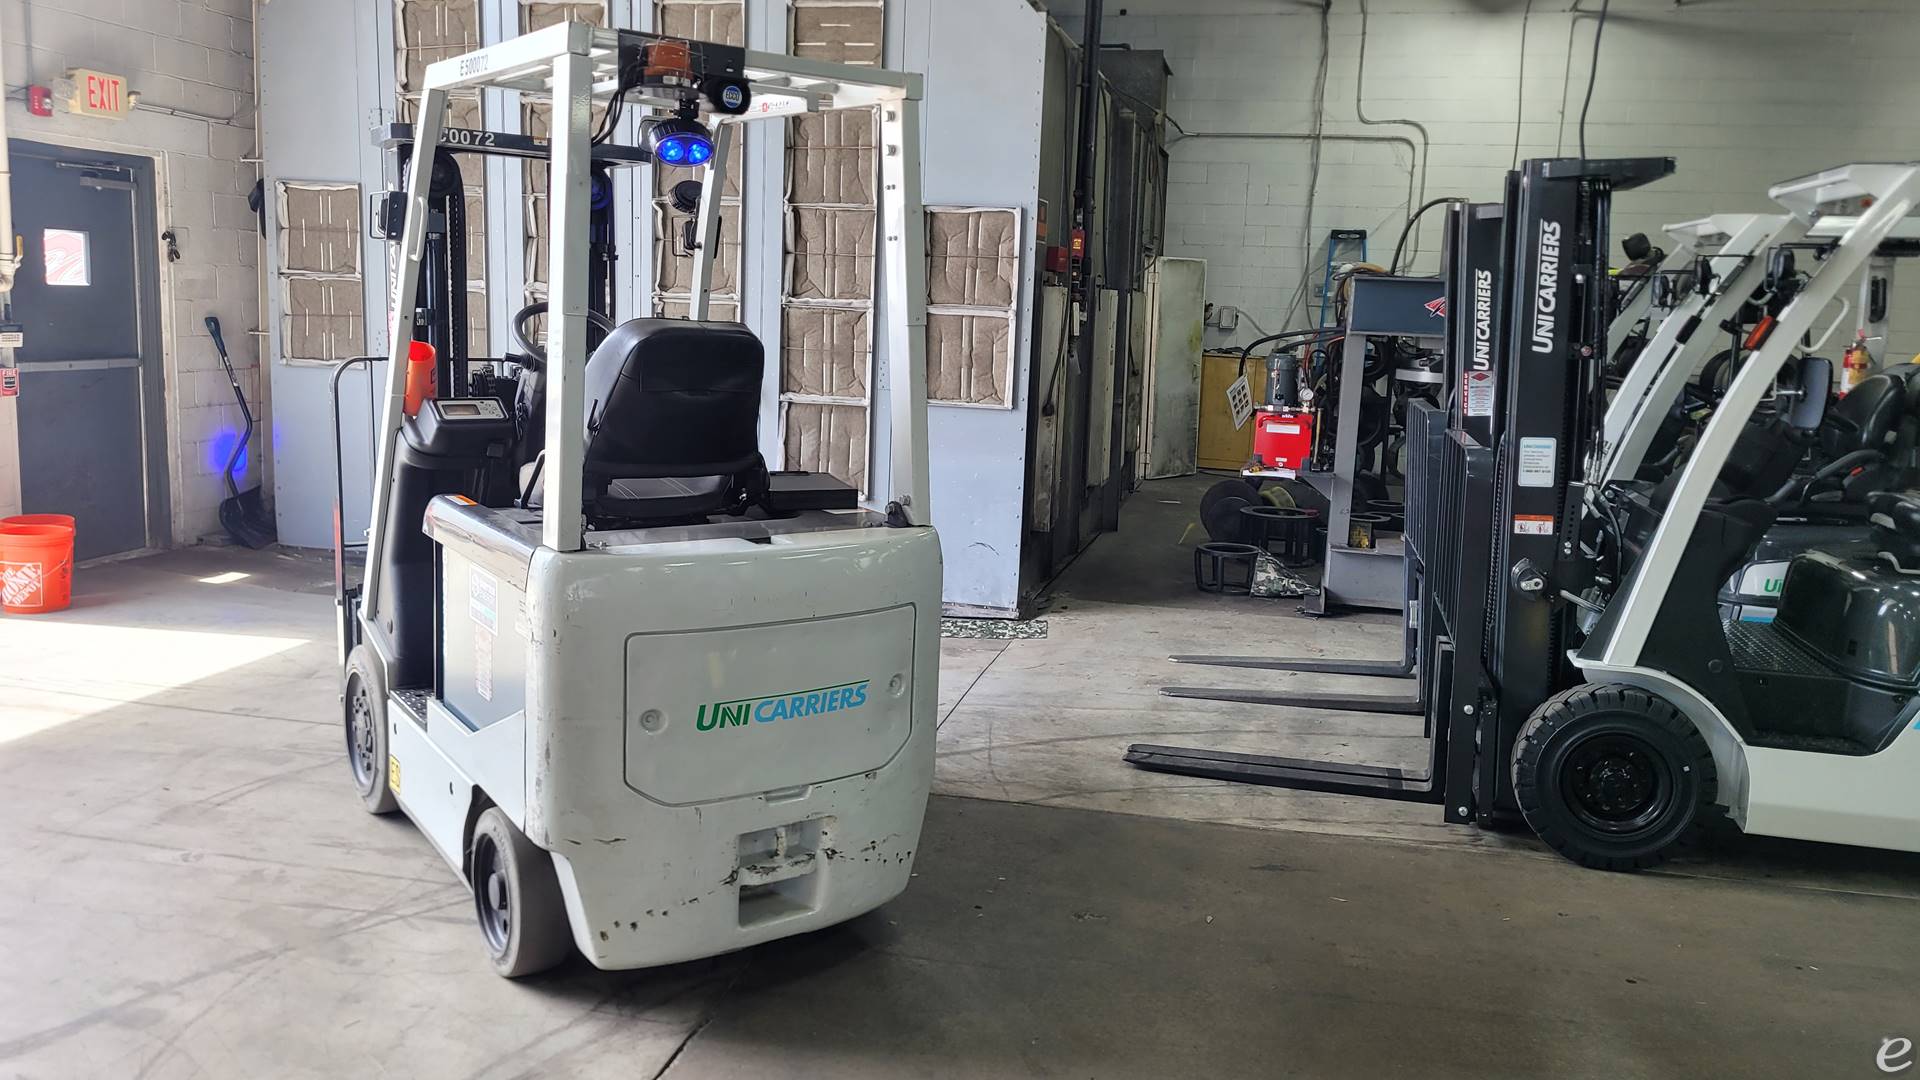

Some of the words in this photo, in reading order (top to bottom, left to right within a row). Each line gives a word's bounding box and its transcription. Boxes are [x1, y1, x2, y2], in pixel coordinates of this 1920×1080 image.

[87, 75, 120, 112] EXIT
[1472, 269, 1492, 371] UNICARRIERS
[1531, 219, 1561, 353] UNICARRIERS
[696, 681, 869, 731] UNICARRIERS
